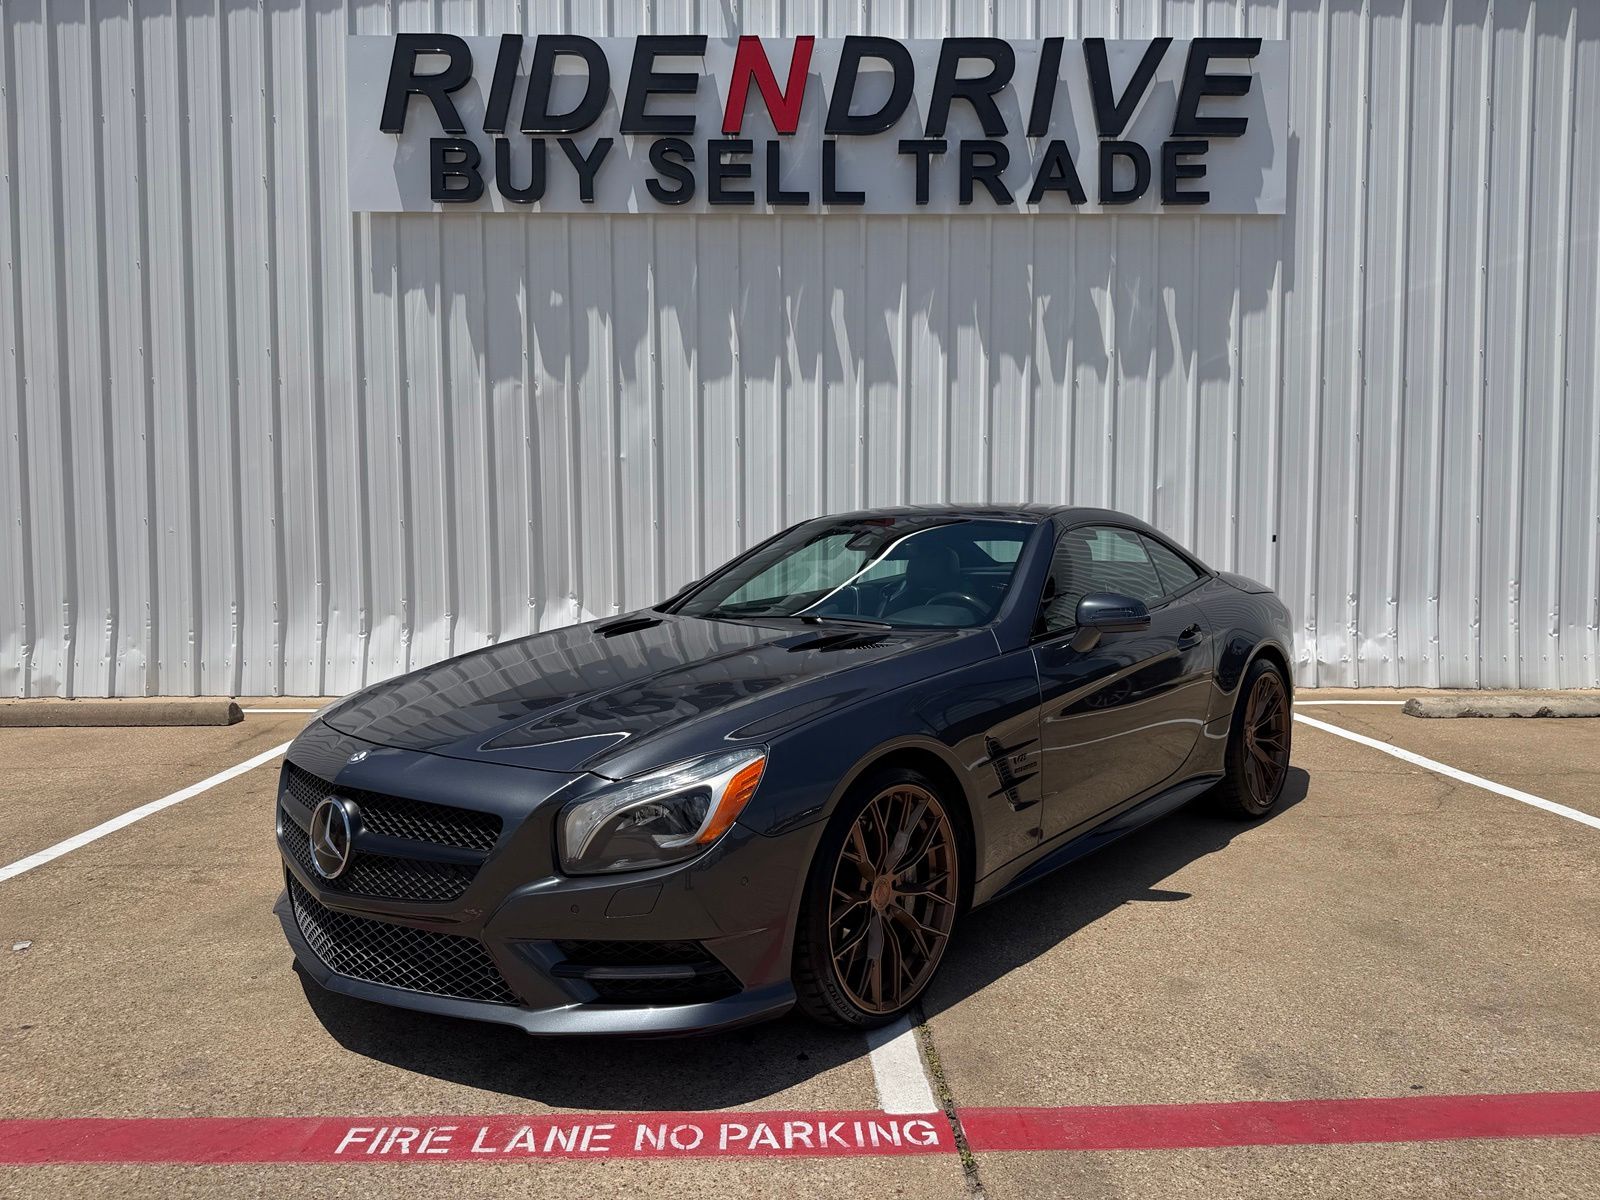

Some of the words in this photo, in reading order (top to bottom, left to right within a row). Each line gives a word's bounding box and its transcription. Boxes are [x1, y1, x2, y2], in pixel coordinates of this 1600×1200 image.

[430, 138, 614, 204] BUY
[645, 138, 866, 206] SELL
[898, 139, 1211, 206] TRADE
[334, 1126, 459, 1154] FIRE
[470, 1124, 616, 1153] LANE
[634, 1123, 704, 1151] NO
[719, 1119, 940, 1151] PARKING
